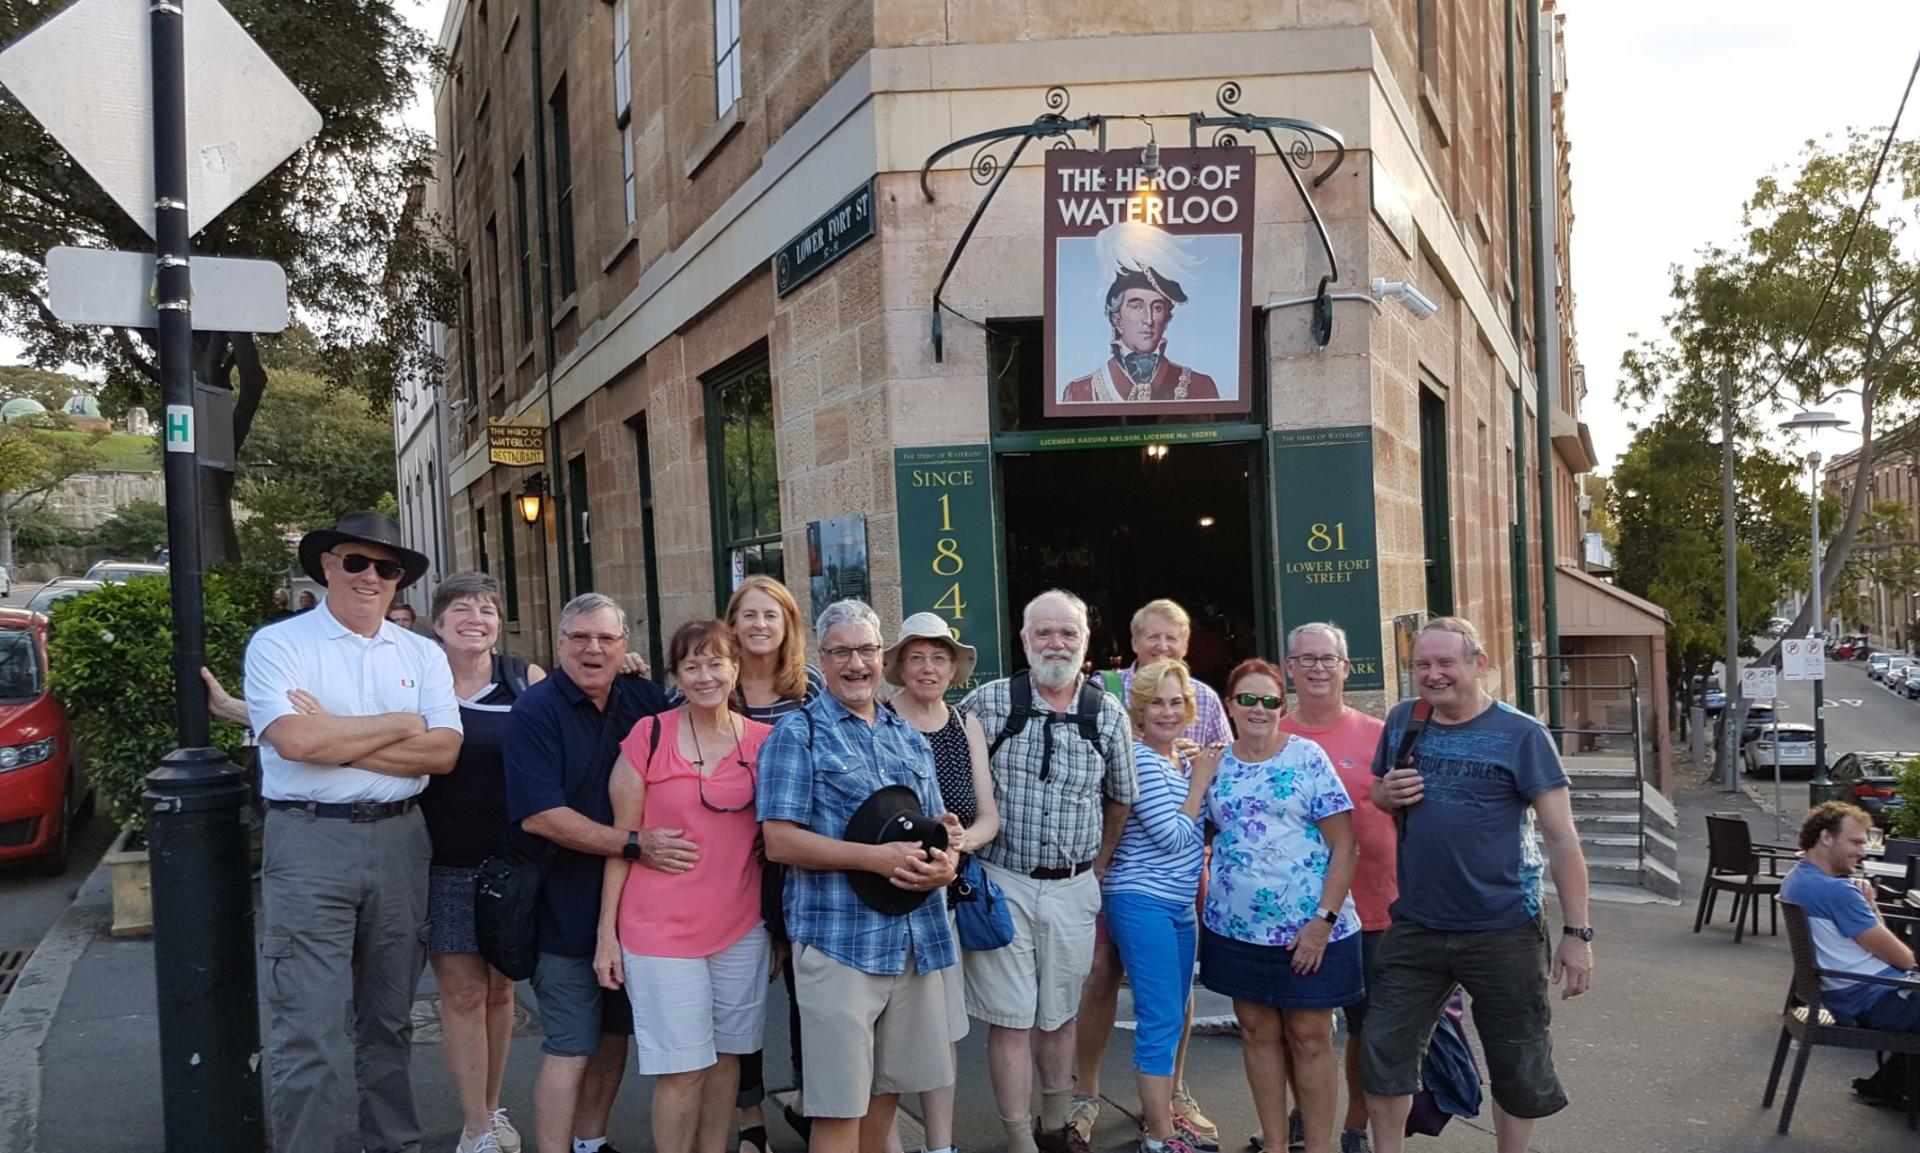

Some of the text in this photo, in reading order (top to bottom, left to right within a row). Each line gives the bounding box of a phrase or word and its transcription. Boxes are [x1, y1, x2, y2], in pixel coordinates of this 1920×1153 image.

[1058, 164, 1240, 192] THE HERO OF
[1057, 195, 1239, 226] WATERLOO
[796, 227, 825, 264] LOWER
[828, 206, 852, 241] FORT
[856, 193, 868, 220] ST
[169, 413, 189, 442] H
[490, 427, 543, 436] THE HERO OF
[490, 437, 543, 448] WATERLOO
[1297, 433, 1316, 441] HERO
[1327, 431, 1364, 440] WATERLOO
[493, 450, 541, 463] RESTAURANT
[1307, 522, 1347, 552] 81
[1286, 559, 1372, 574] LOWER FORT
[1306, 572, 1352, 584] STREET
